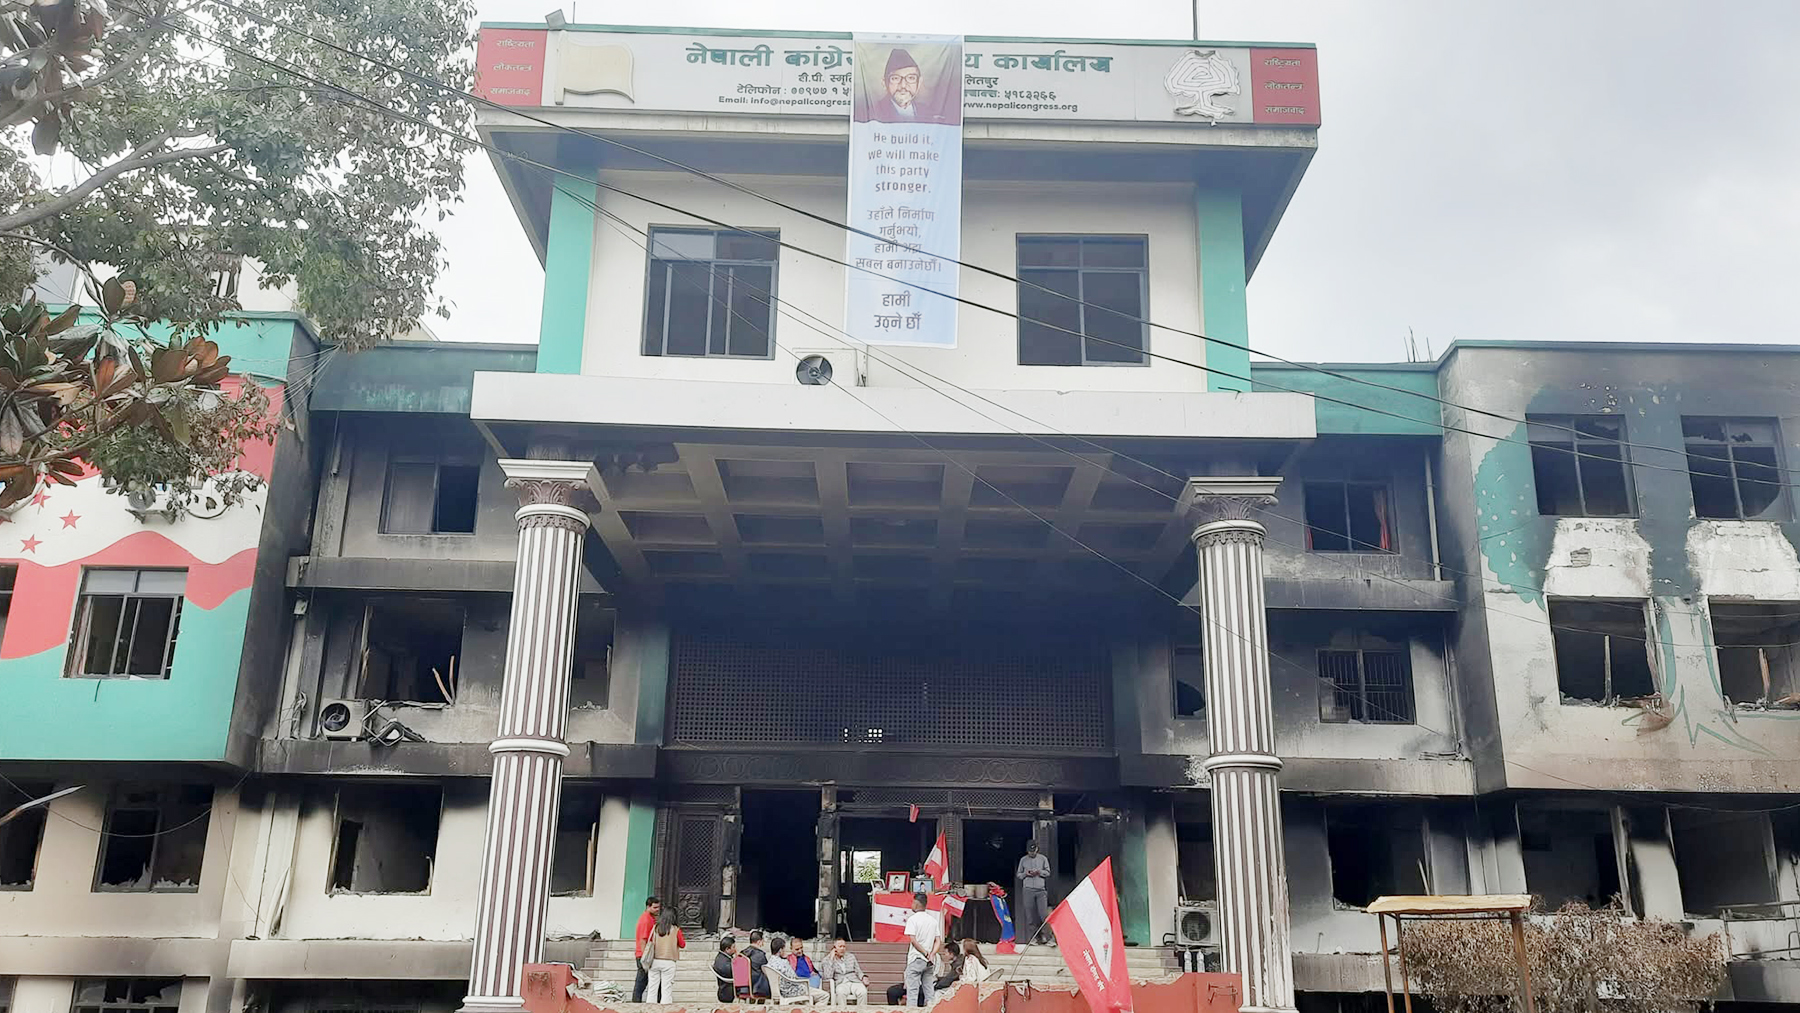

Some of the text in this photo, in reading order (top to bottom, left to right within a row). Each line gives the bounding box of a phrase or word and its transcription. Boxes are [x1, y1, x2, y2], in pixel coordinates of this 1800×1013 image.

[685, 42, 853, 70] नेपाली कांग्रे
[992, 50, 1113, 73] कार्यालय
[719, 96, 748, 104] Email:
[873, 132, 934, 146] He build it,
[868, 149, 939, 162] we will make
[876, 163, 930, 179] this party
[875, 181, 932, 194] stronger.
[898, 205, 935, 221] निर्माण
[881, 289, 911, 308] हामी
[873, 311, 903, 333] उठ्ने
